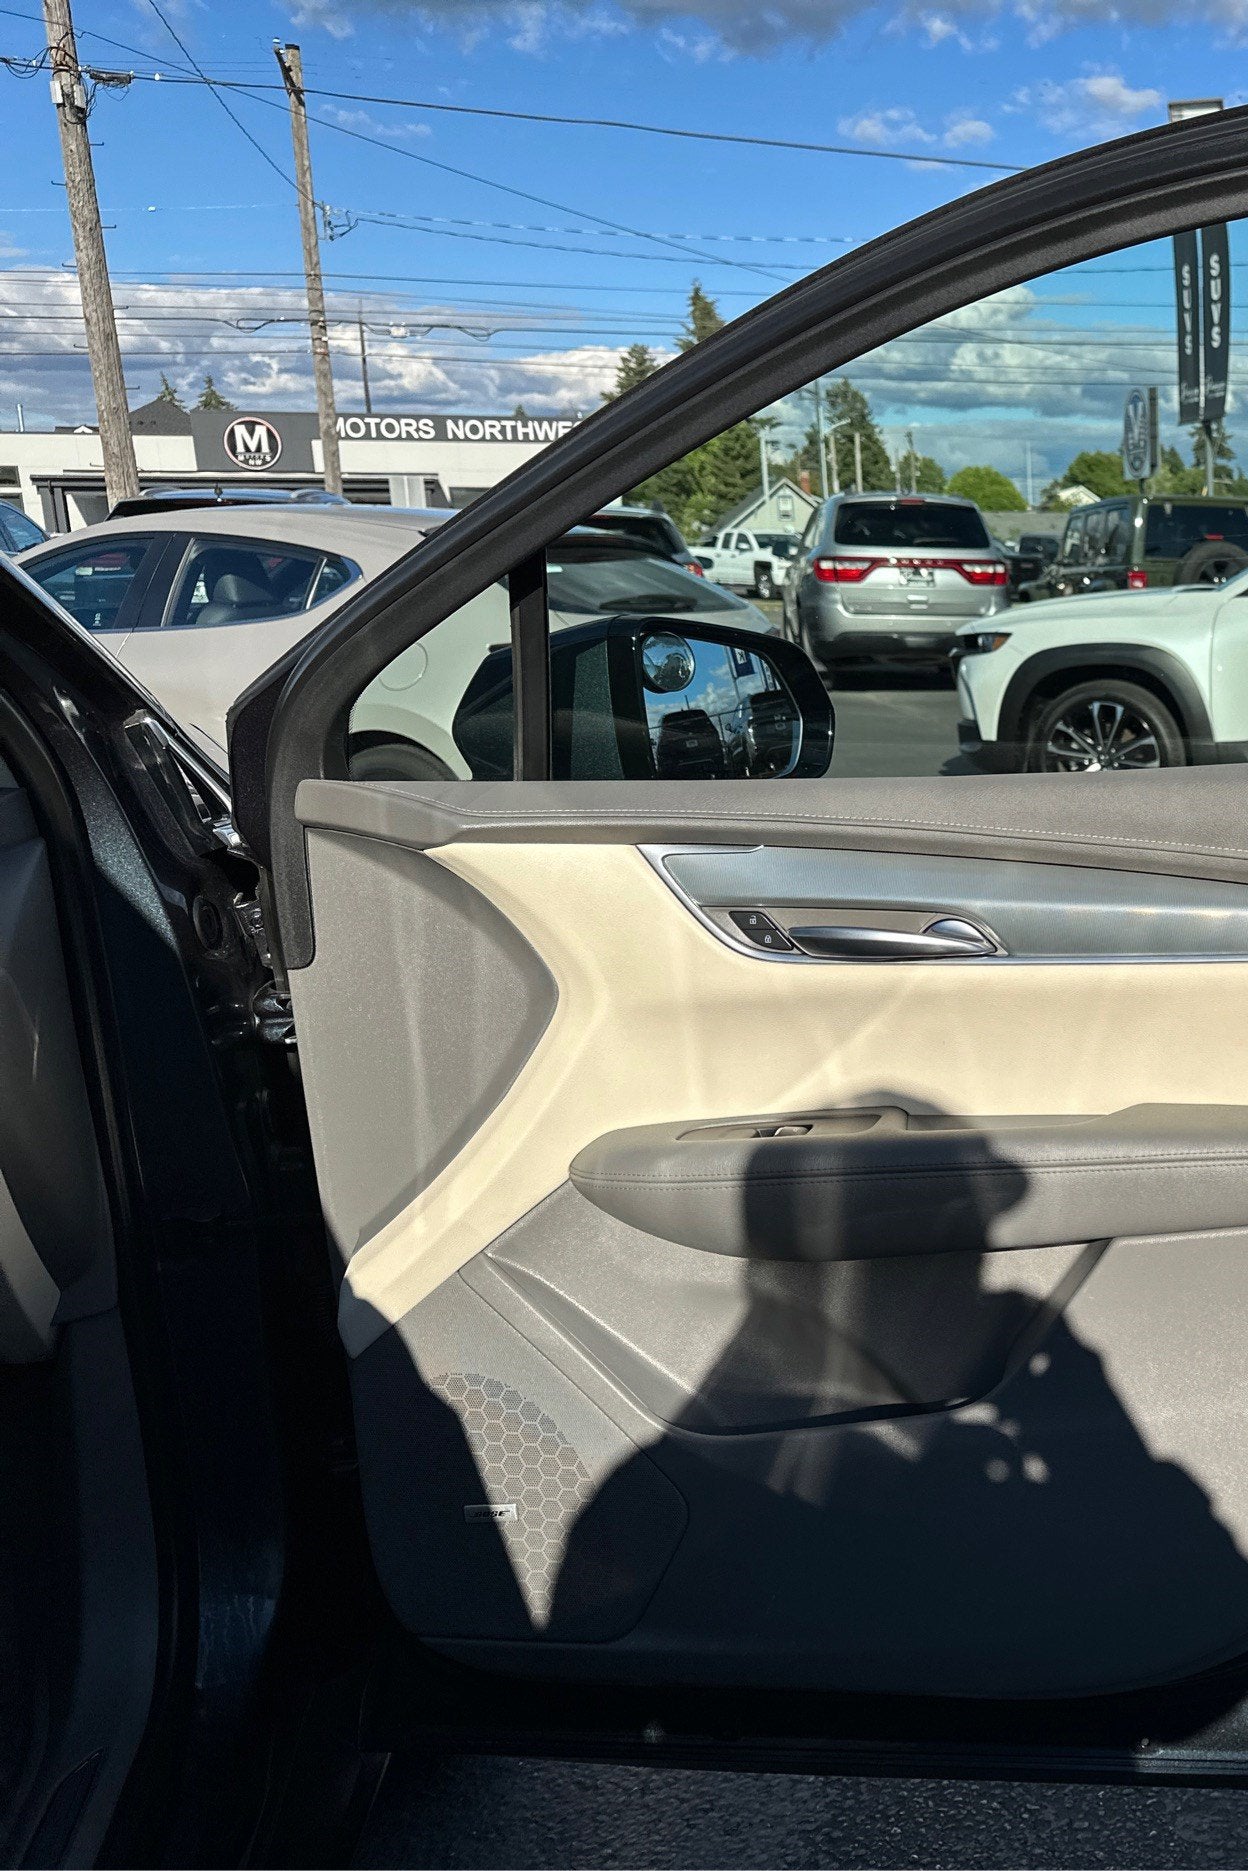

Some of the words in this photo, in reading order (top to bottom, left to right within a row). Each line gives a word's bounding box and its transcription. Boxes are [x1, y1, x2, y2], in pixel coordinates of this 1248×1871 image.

[1209, 252, 1222, 349] SUVS
[233, 424, 270, 453] M
[445, 419, 583, 441] NORTHWE
